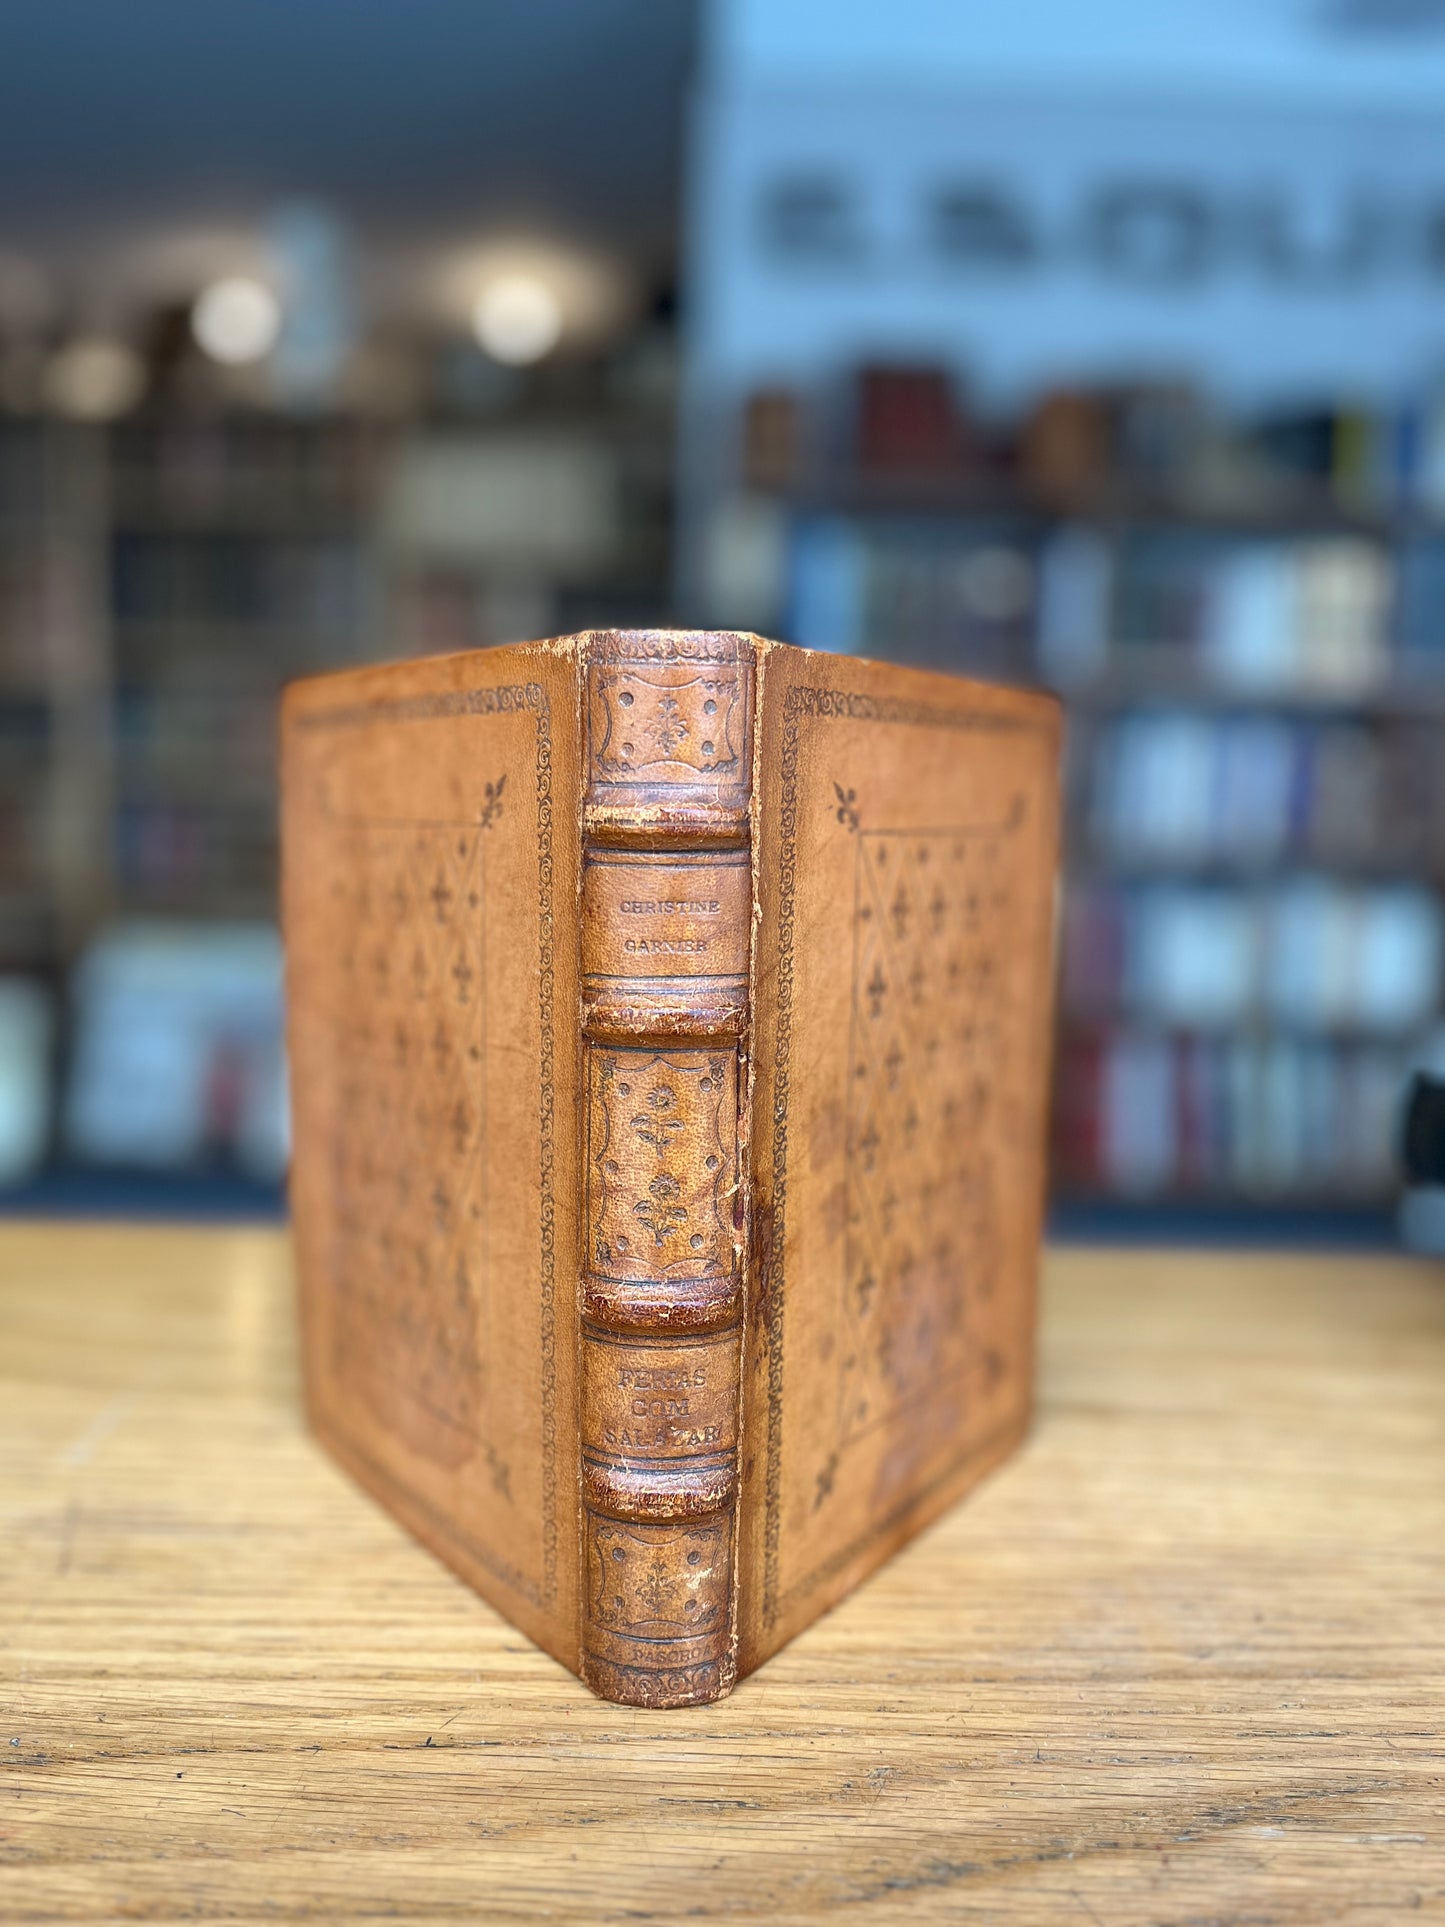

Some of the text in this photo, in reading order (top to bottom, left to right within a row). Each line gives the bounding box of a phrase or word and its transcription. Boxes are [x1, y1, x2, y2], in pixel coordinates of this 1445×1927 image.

[619, 900, 721, 914] CHRISTINE
[624, 938, 708, 954] GARNIER
[631, 1398, 690, 1417] COM
